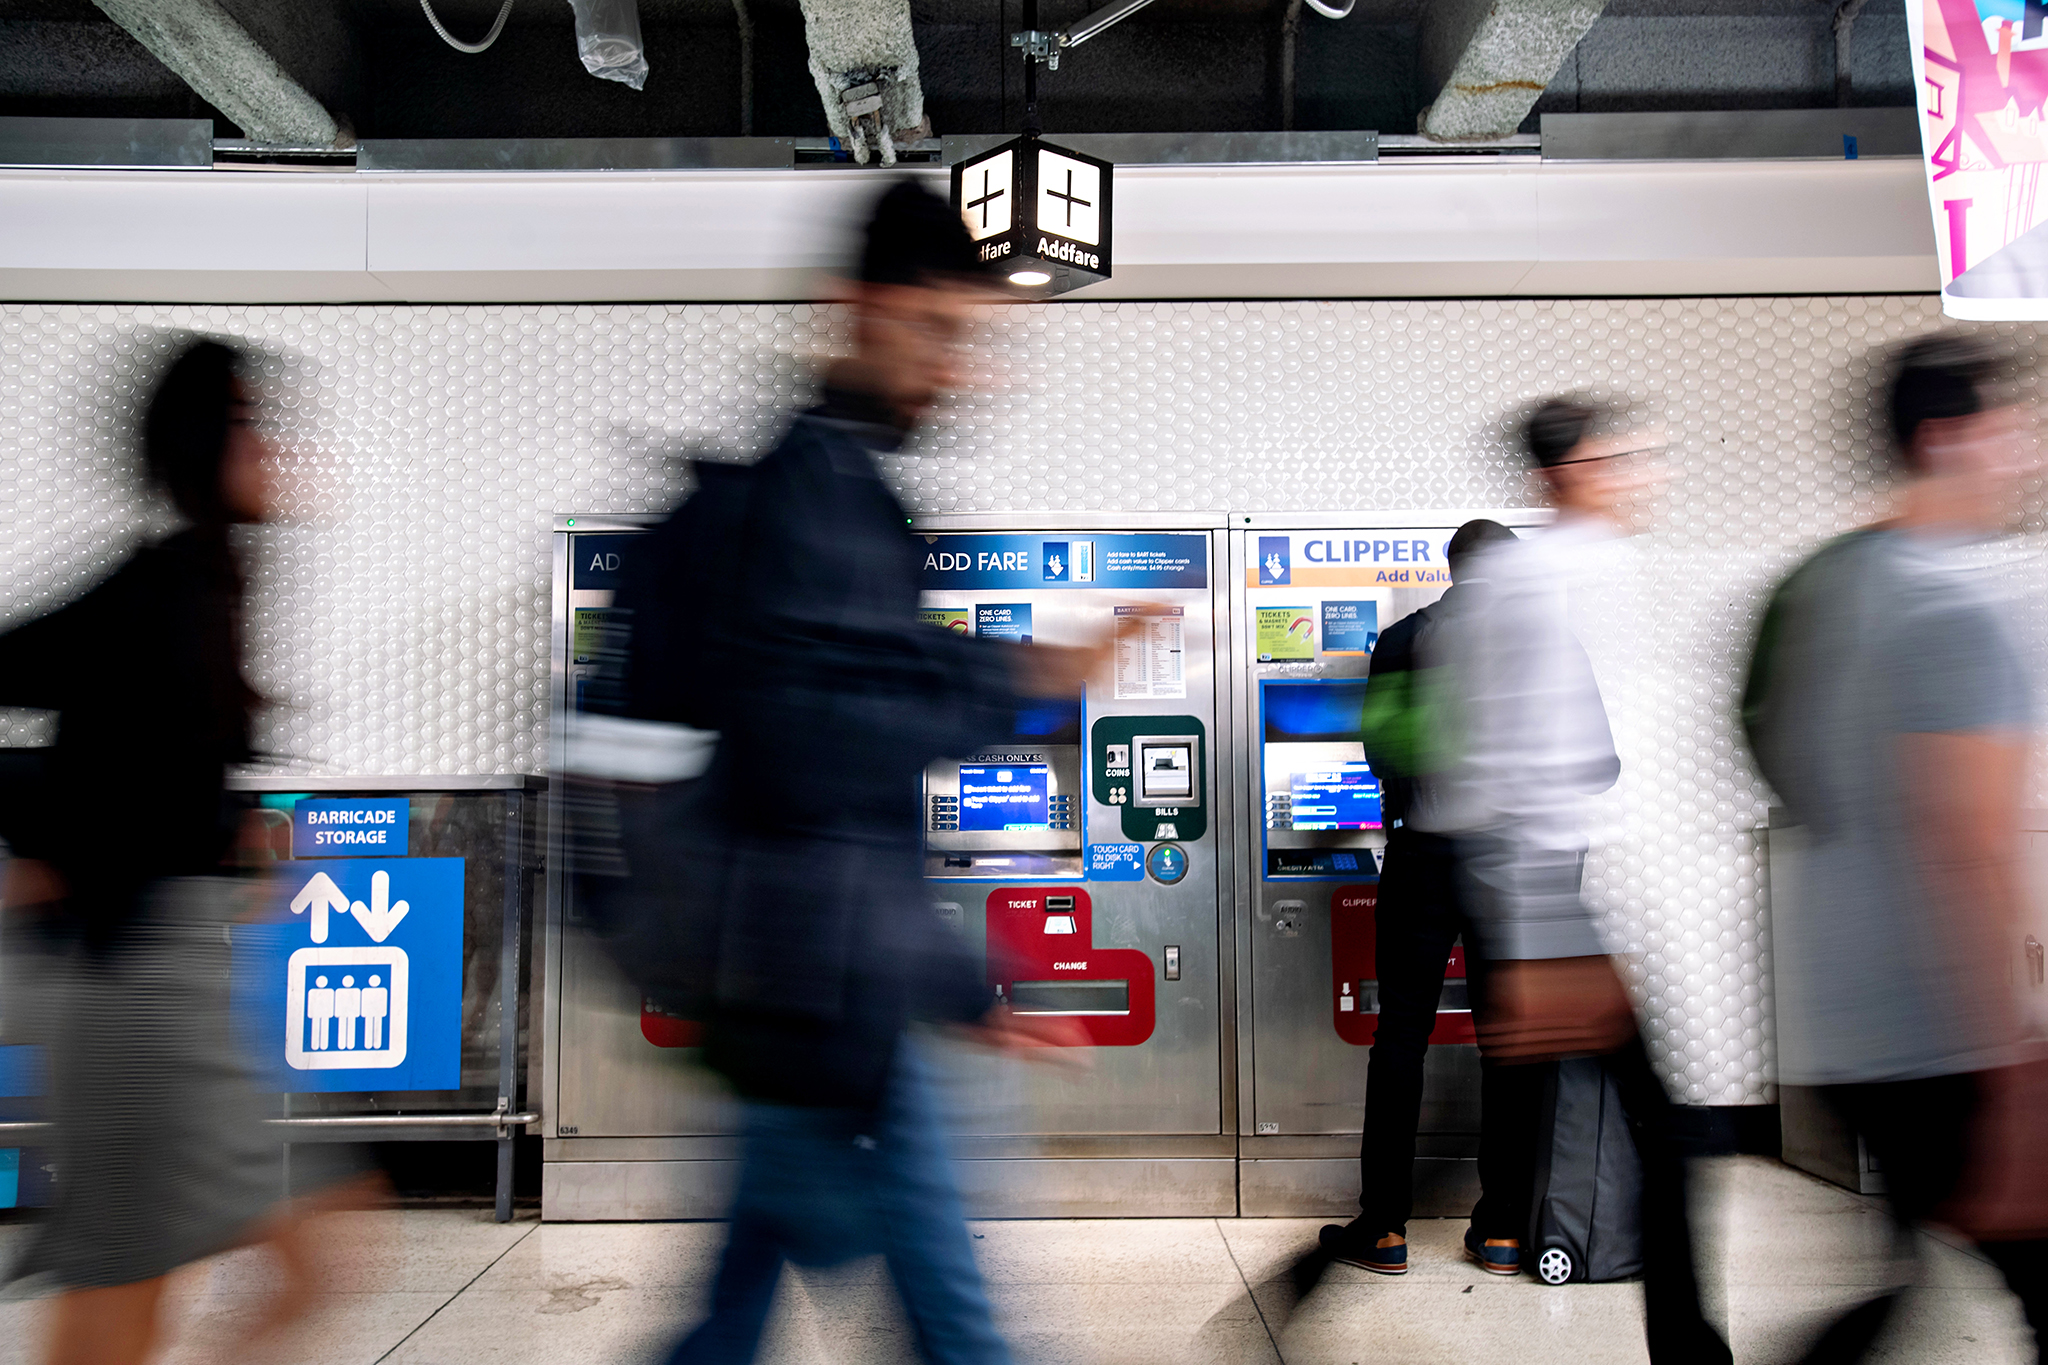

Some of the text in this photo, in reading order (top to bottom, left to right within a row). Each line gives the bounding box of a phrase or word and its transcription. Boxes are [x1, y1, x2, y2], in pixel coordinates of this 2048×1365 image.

[978, 240, 1011, 262] dfare
[1036, 236, 1100, 269] Addfare
[1304, 540, 1430, 562] CLIPPER
[590, 553, 621, 571] AD
[924, 552, 1028, 571] ADD FARE
[1376, 570, 1451, 582] Add Valu
[1106, 769, 1130, 777] COINS
[308, 810, 395, 825] BARRICADE
[1156, 808, 1178, 816] BILLS
[315, 830, 386, 844] STORAGE
[1008, 900, 1037, 908] TICKET
[1054, 962, 1087, 970] CHANGE
